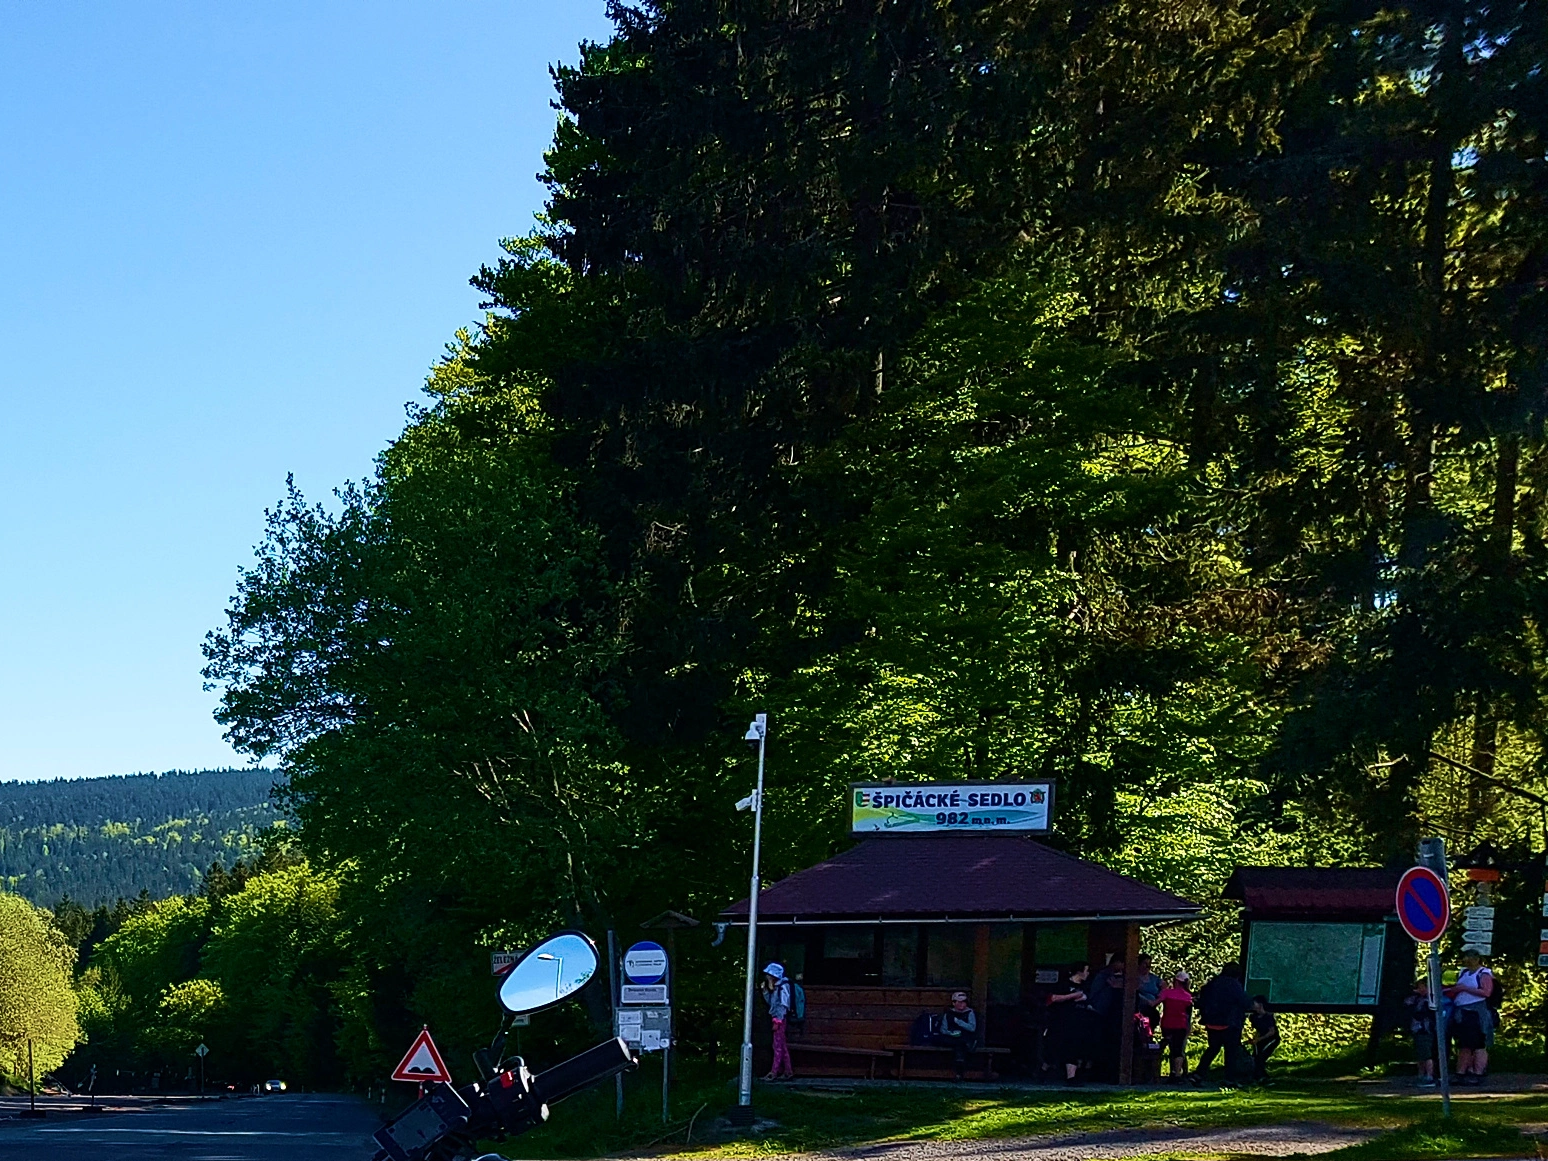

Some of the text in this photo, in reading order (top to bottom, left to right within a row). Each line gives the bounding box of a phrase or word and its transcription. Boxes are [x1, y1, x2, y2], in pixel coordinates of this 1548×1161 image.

[872, 790, 1026, 808] ŠPIČÁCKÉ SEDLO
[935, 812, 969, 825] 982
